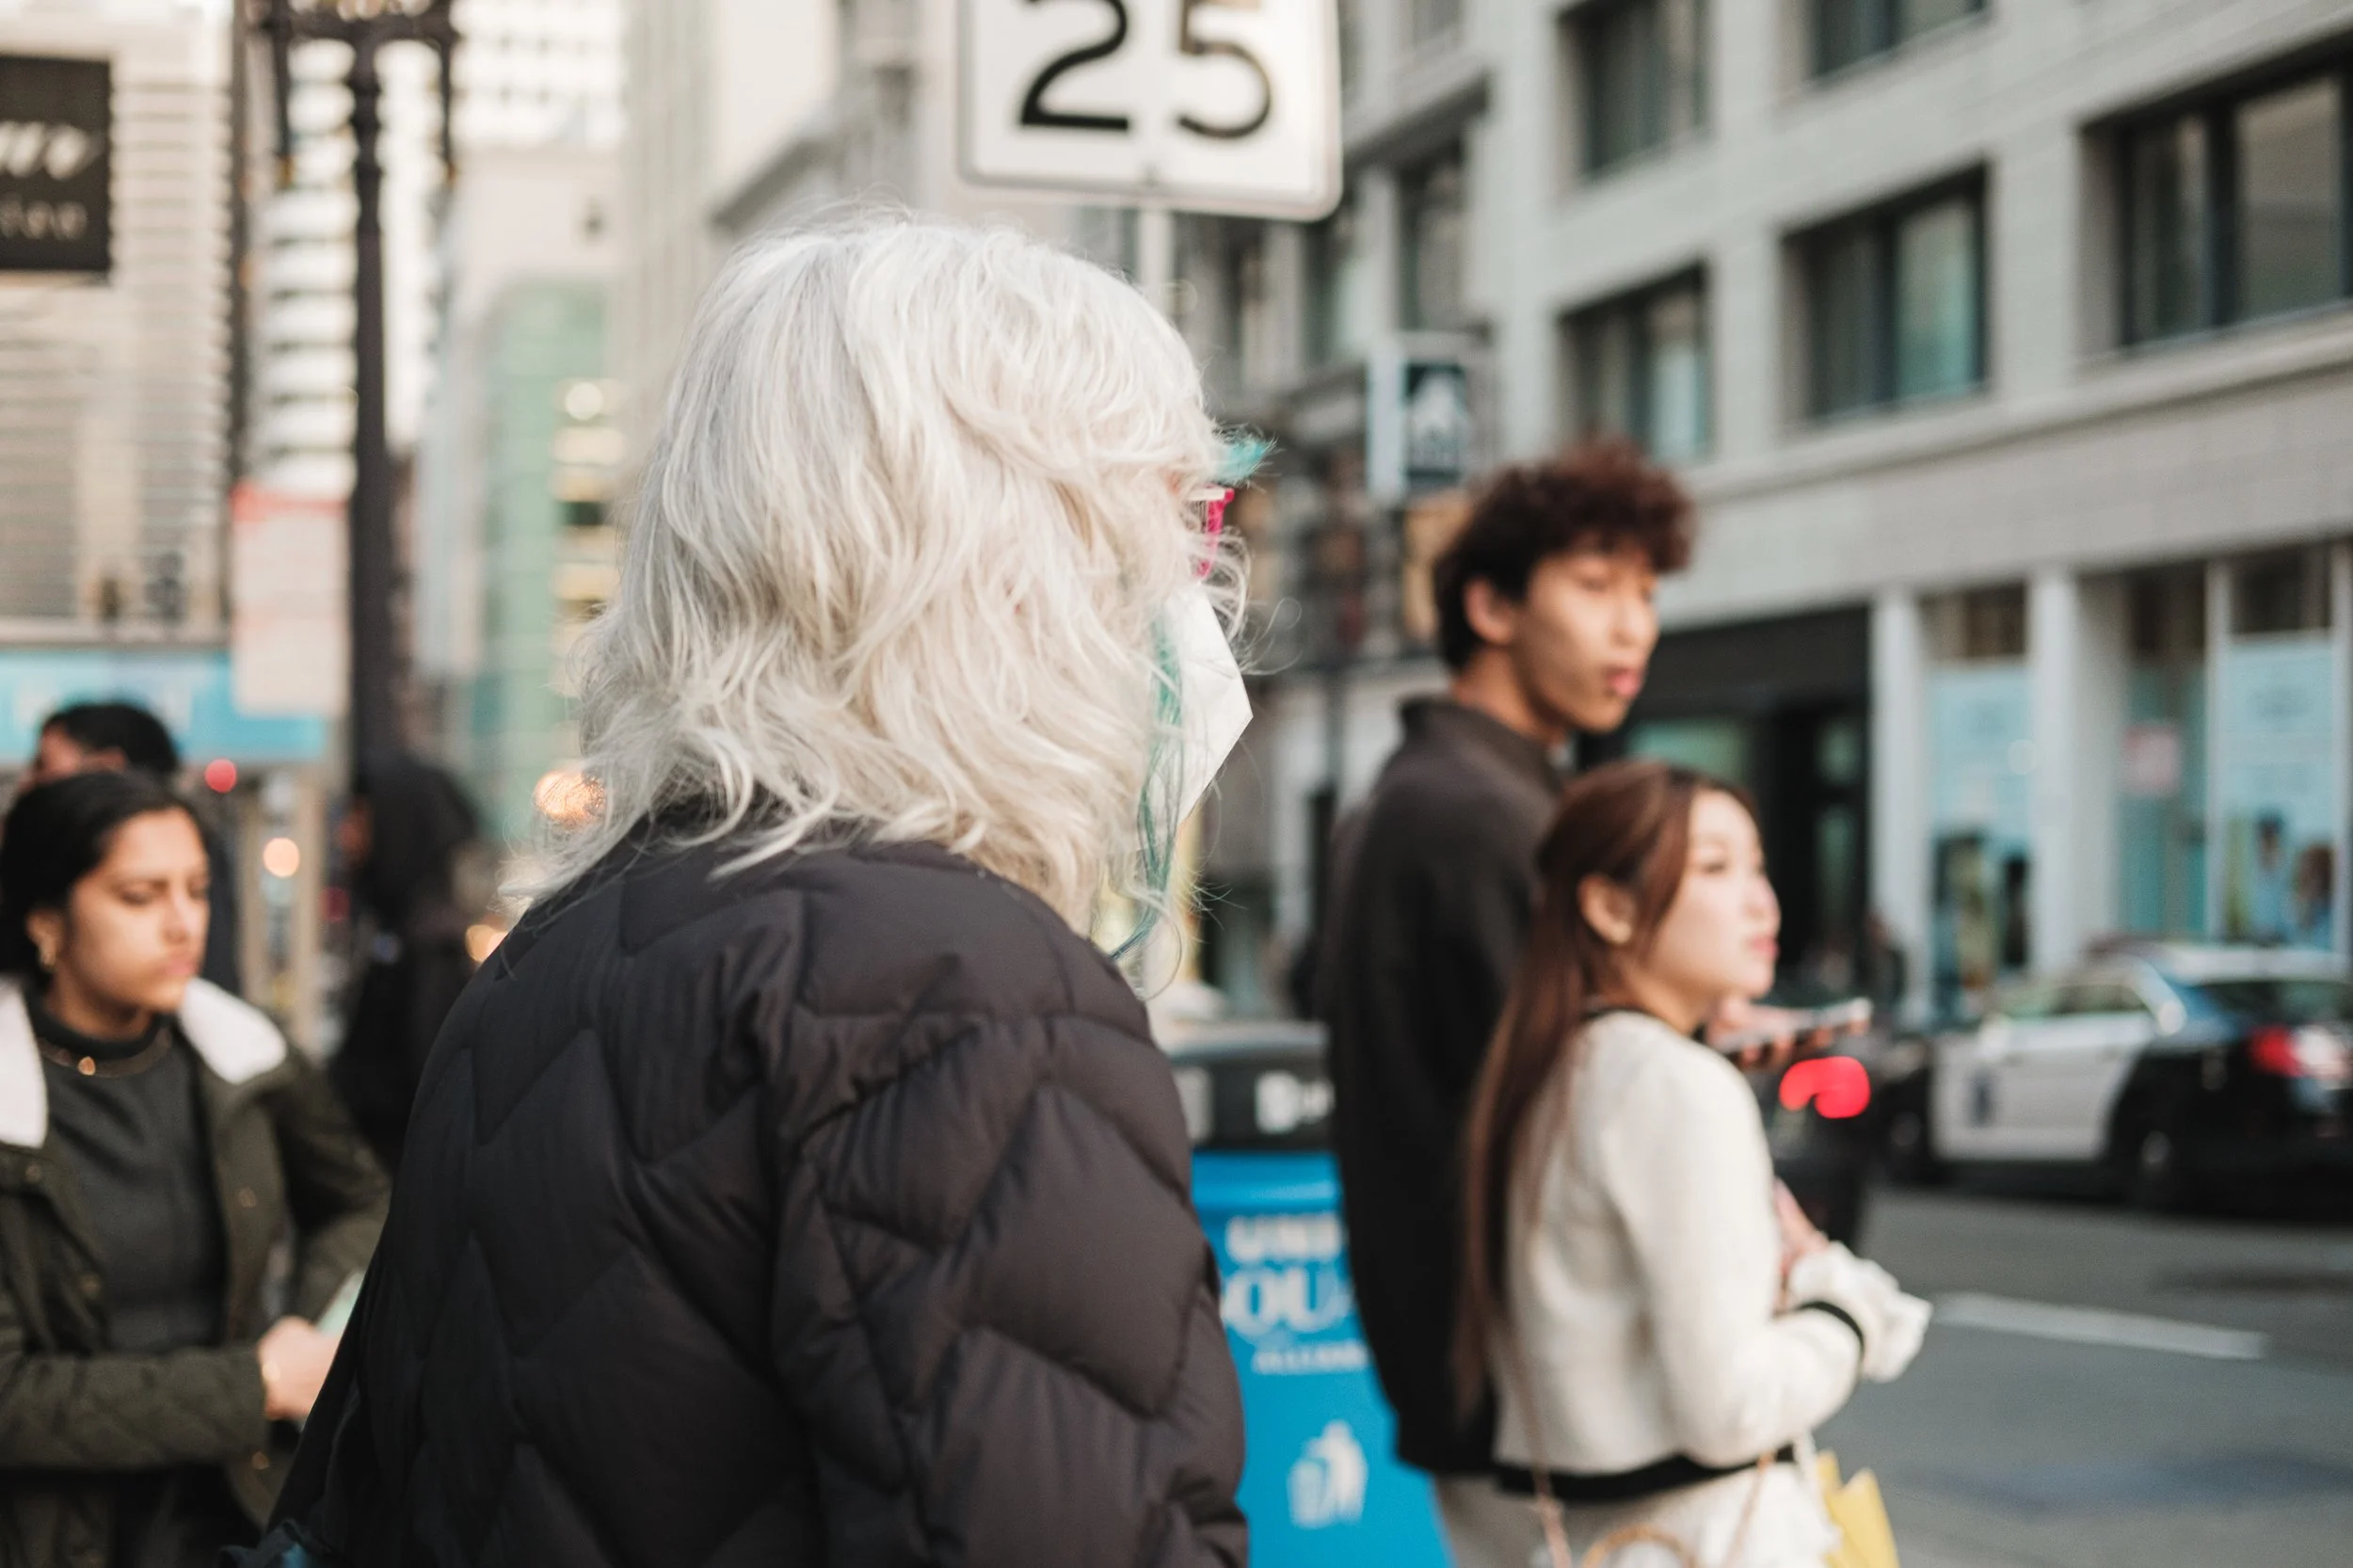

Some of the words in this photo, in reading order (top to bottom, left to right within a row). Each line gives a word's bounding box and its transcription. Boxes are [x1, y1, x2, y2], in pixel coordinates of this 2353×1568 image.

[1019, 0, 1273, 139] 25
[1225, 1213, 1345, 1262] UNI
[1221, 1266, 1353, 1344] QU
